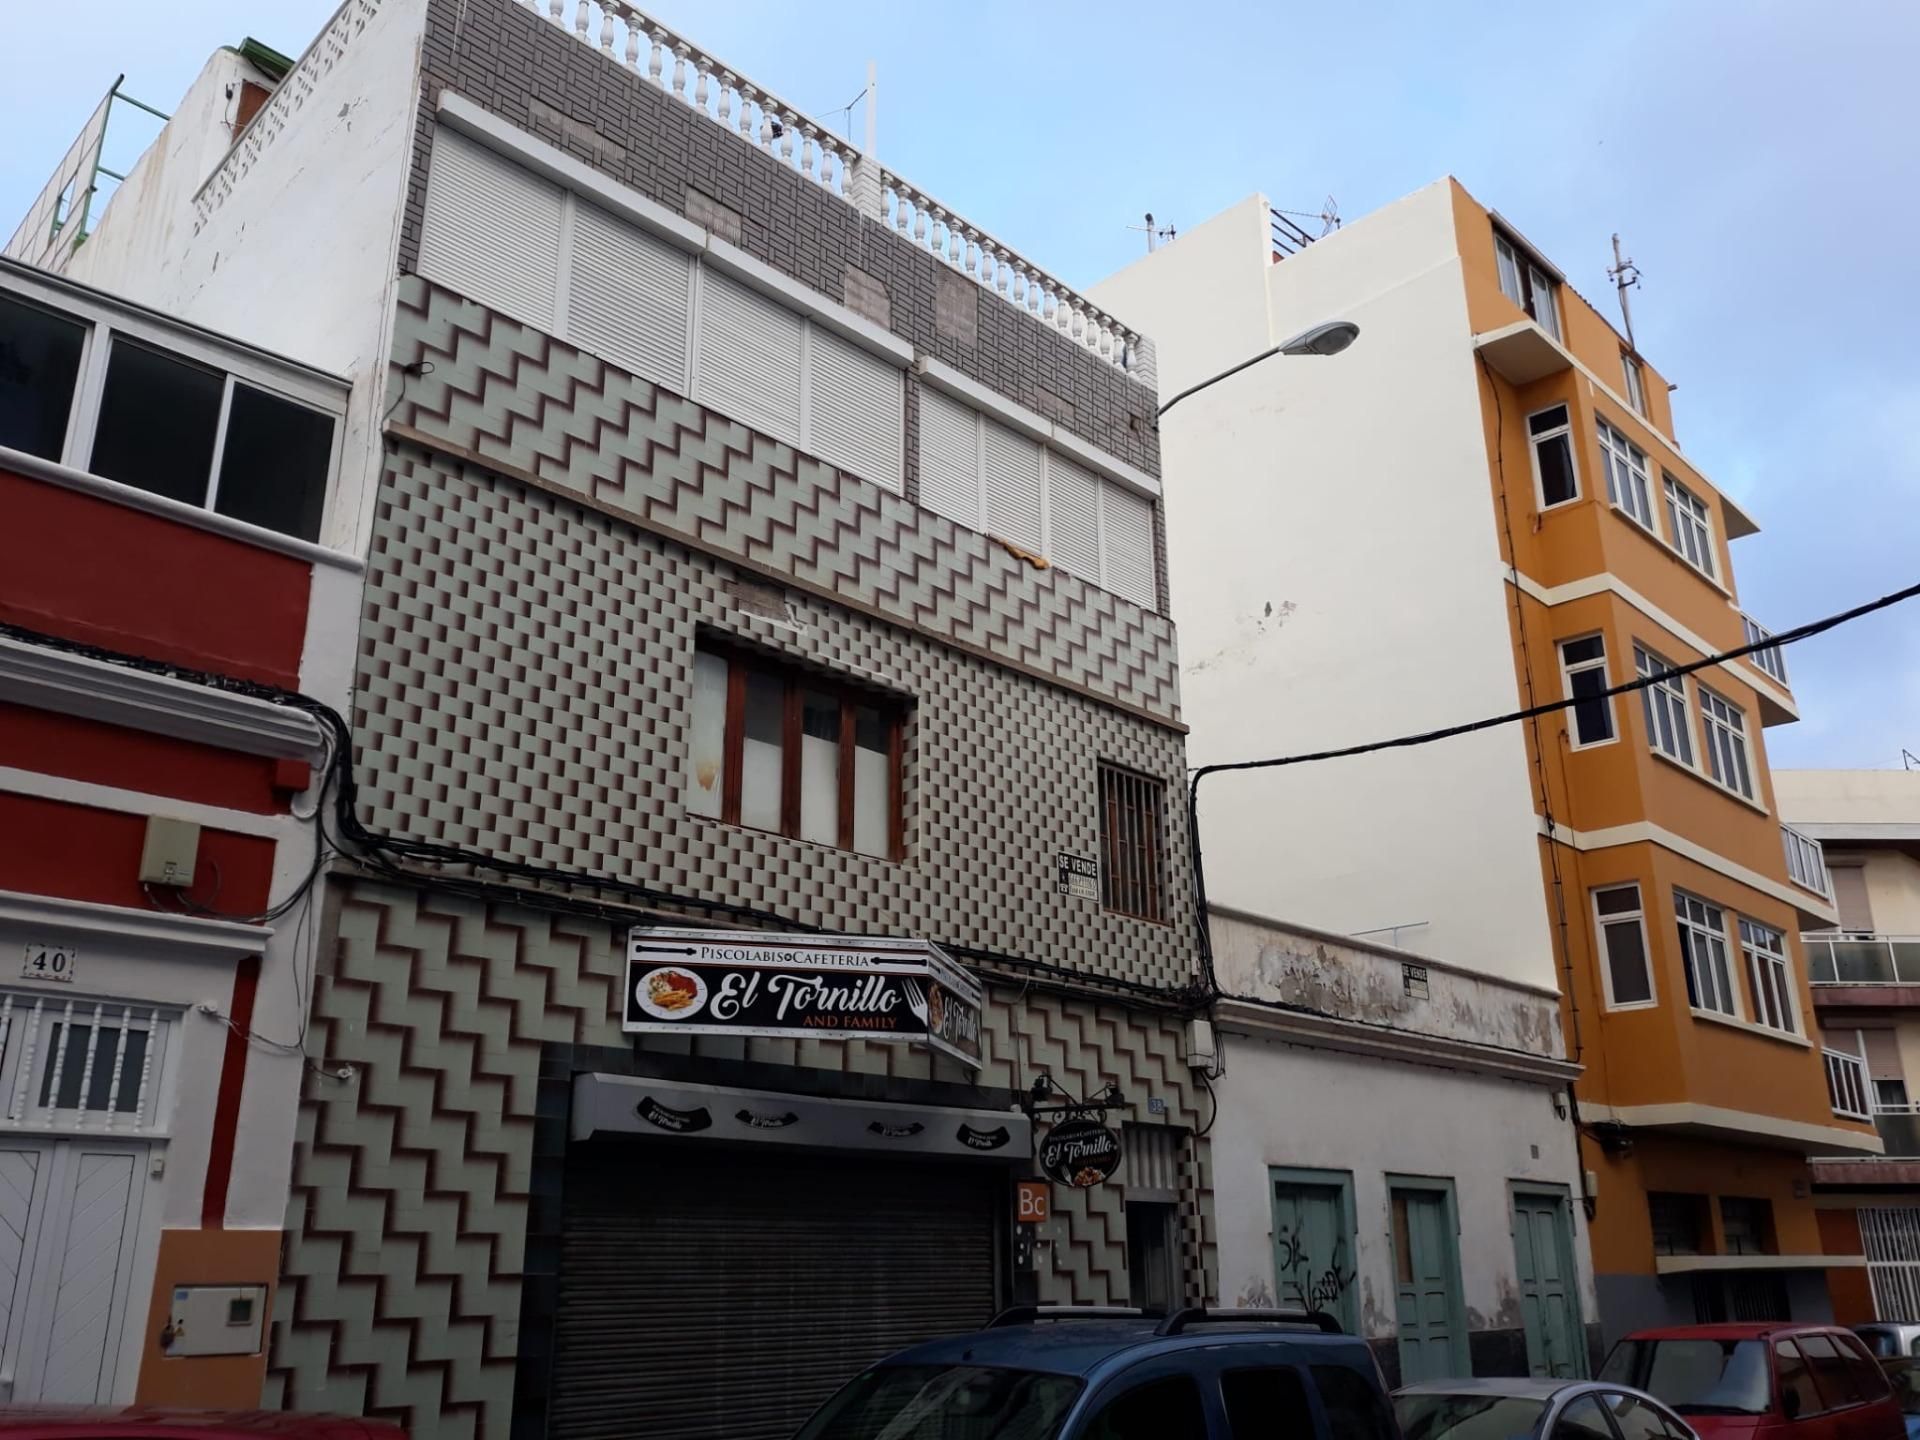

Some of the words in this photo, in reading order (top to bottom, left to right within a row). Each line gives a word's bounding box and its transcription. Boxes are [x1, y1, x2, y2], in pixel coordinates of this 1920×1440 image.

[1059, 855, 1069, 869] SE
[1071, 858, 1096, 876] VENDE
[31, 951, 67, 973] 40
[700, 945, 784, 963] PISCOLABIS
[792, 949, 870, 968] CAFETERÍA
[709, 971, 761, 1021] El
[766, 974, 902, 1022] Tornillo
[803, 1013, 838, 1028] AND
[844, 1015, 897, 1030] FAMILY
[1045, 1142, 1062, 1168] El
[1064, 1135, 1112, 1164] Tornillo
